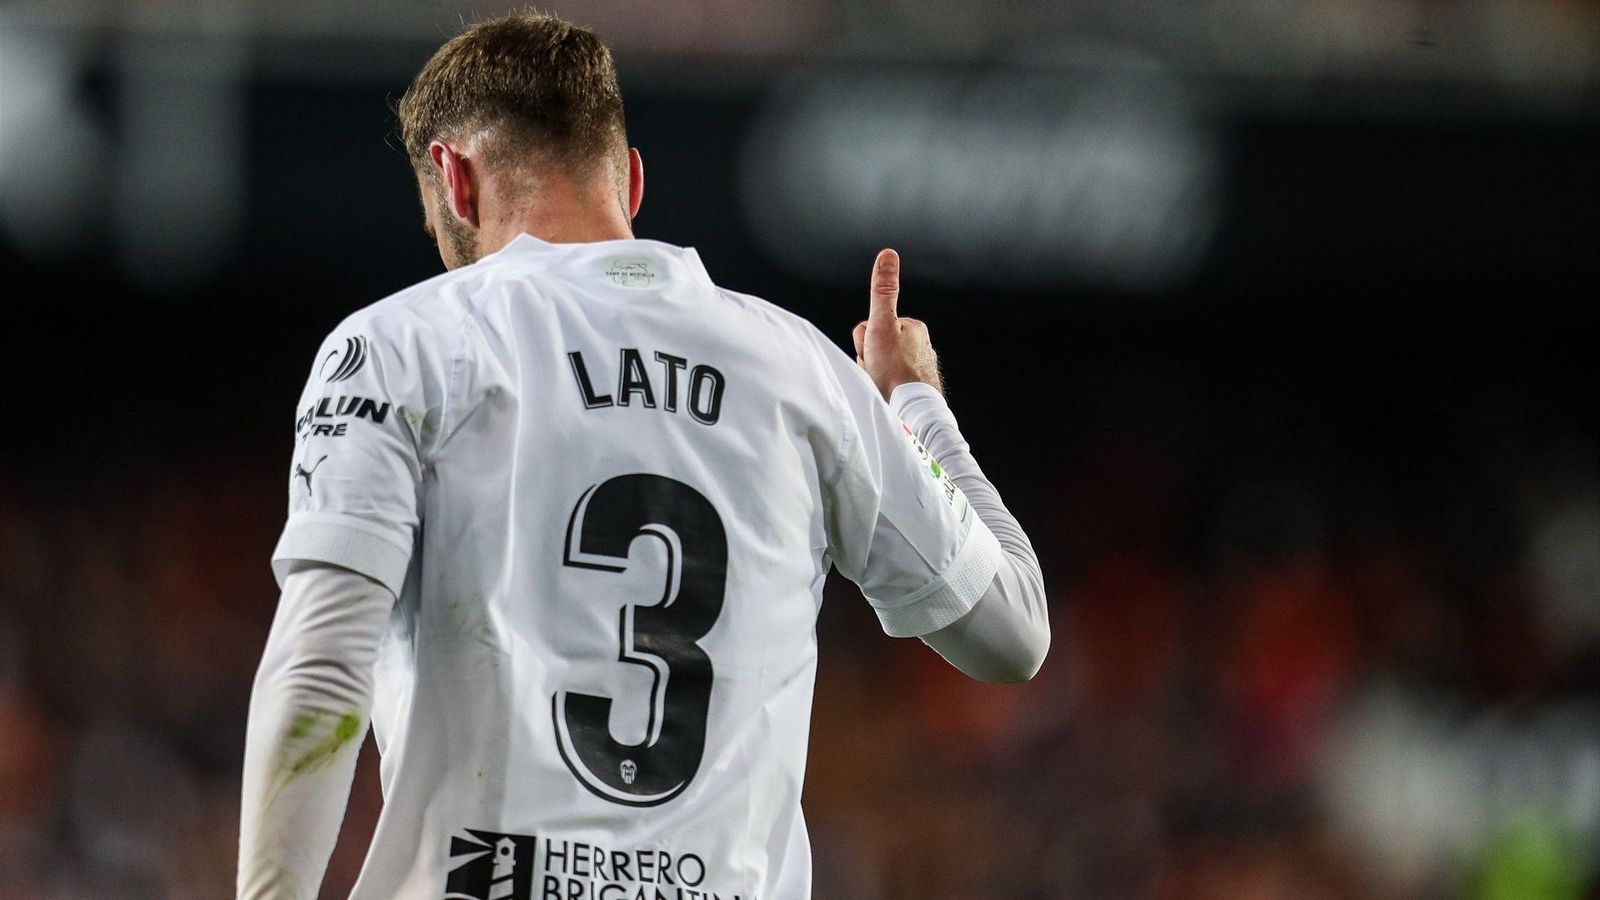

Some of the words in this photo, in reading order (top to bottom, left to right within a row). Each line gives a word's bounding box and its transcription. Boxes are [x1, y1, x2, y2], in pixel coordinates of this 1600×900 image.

[568, 348, 726, 426] LATO
[552, 473, 728, 808] 3
[543, 875, 758, 900] BRIGA
[545, 838, 706, 887] HERRERO
